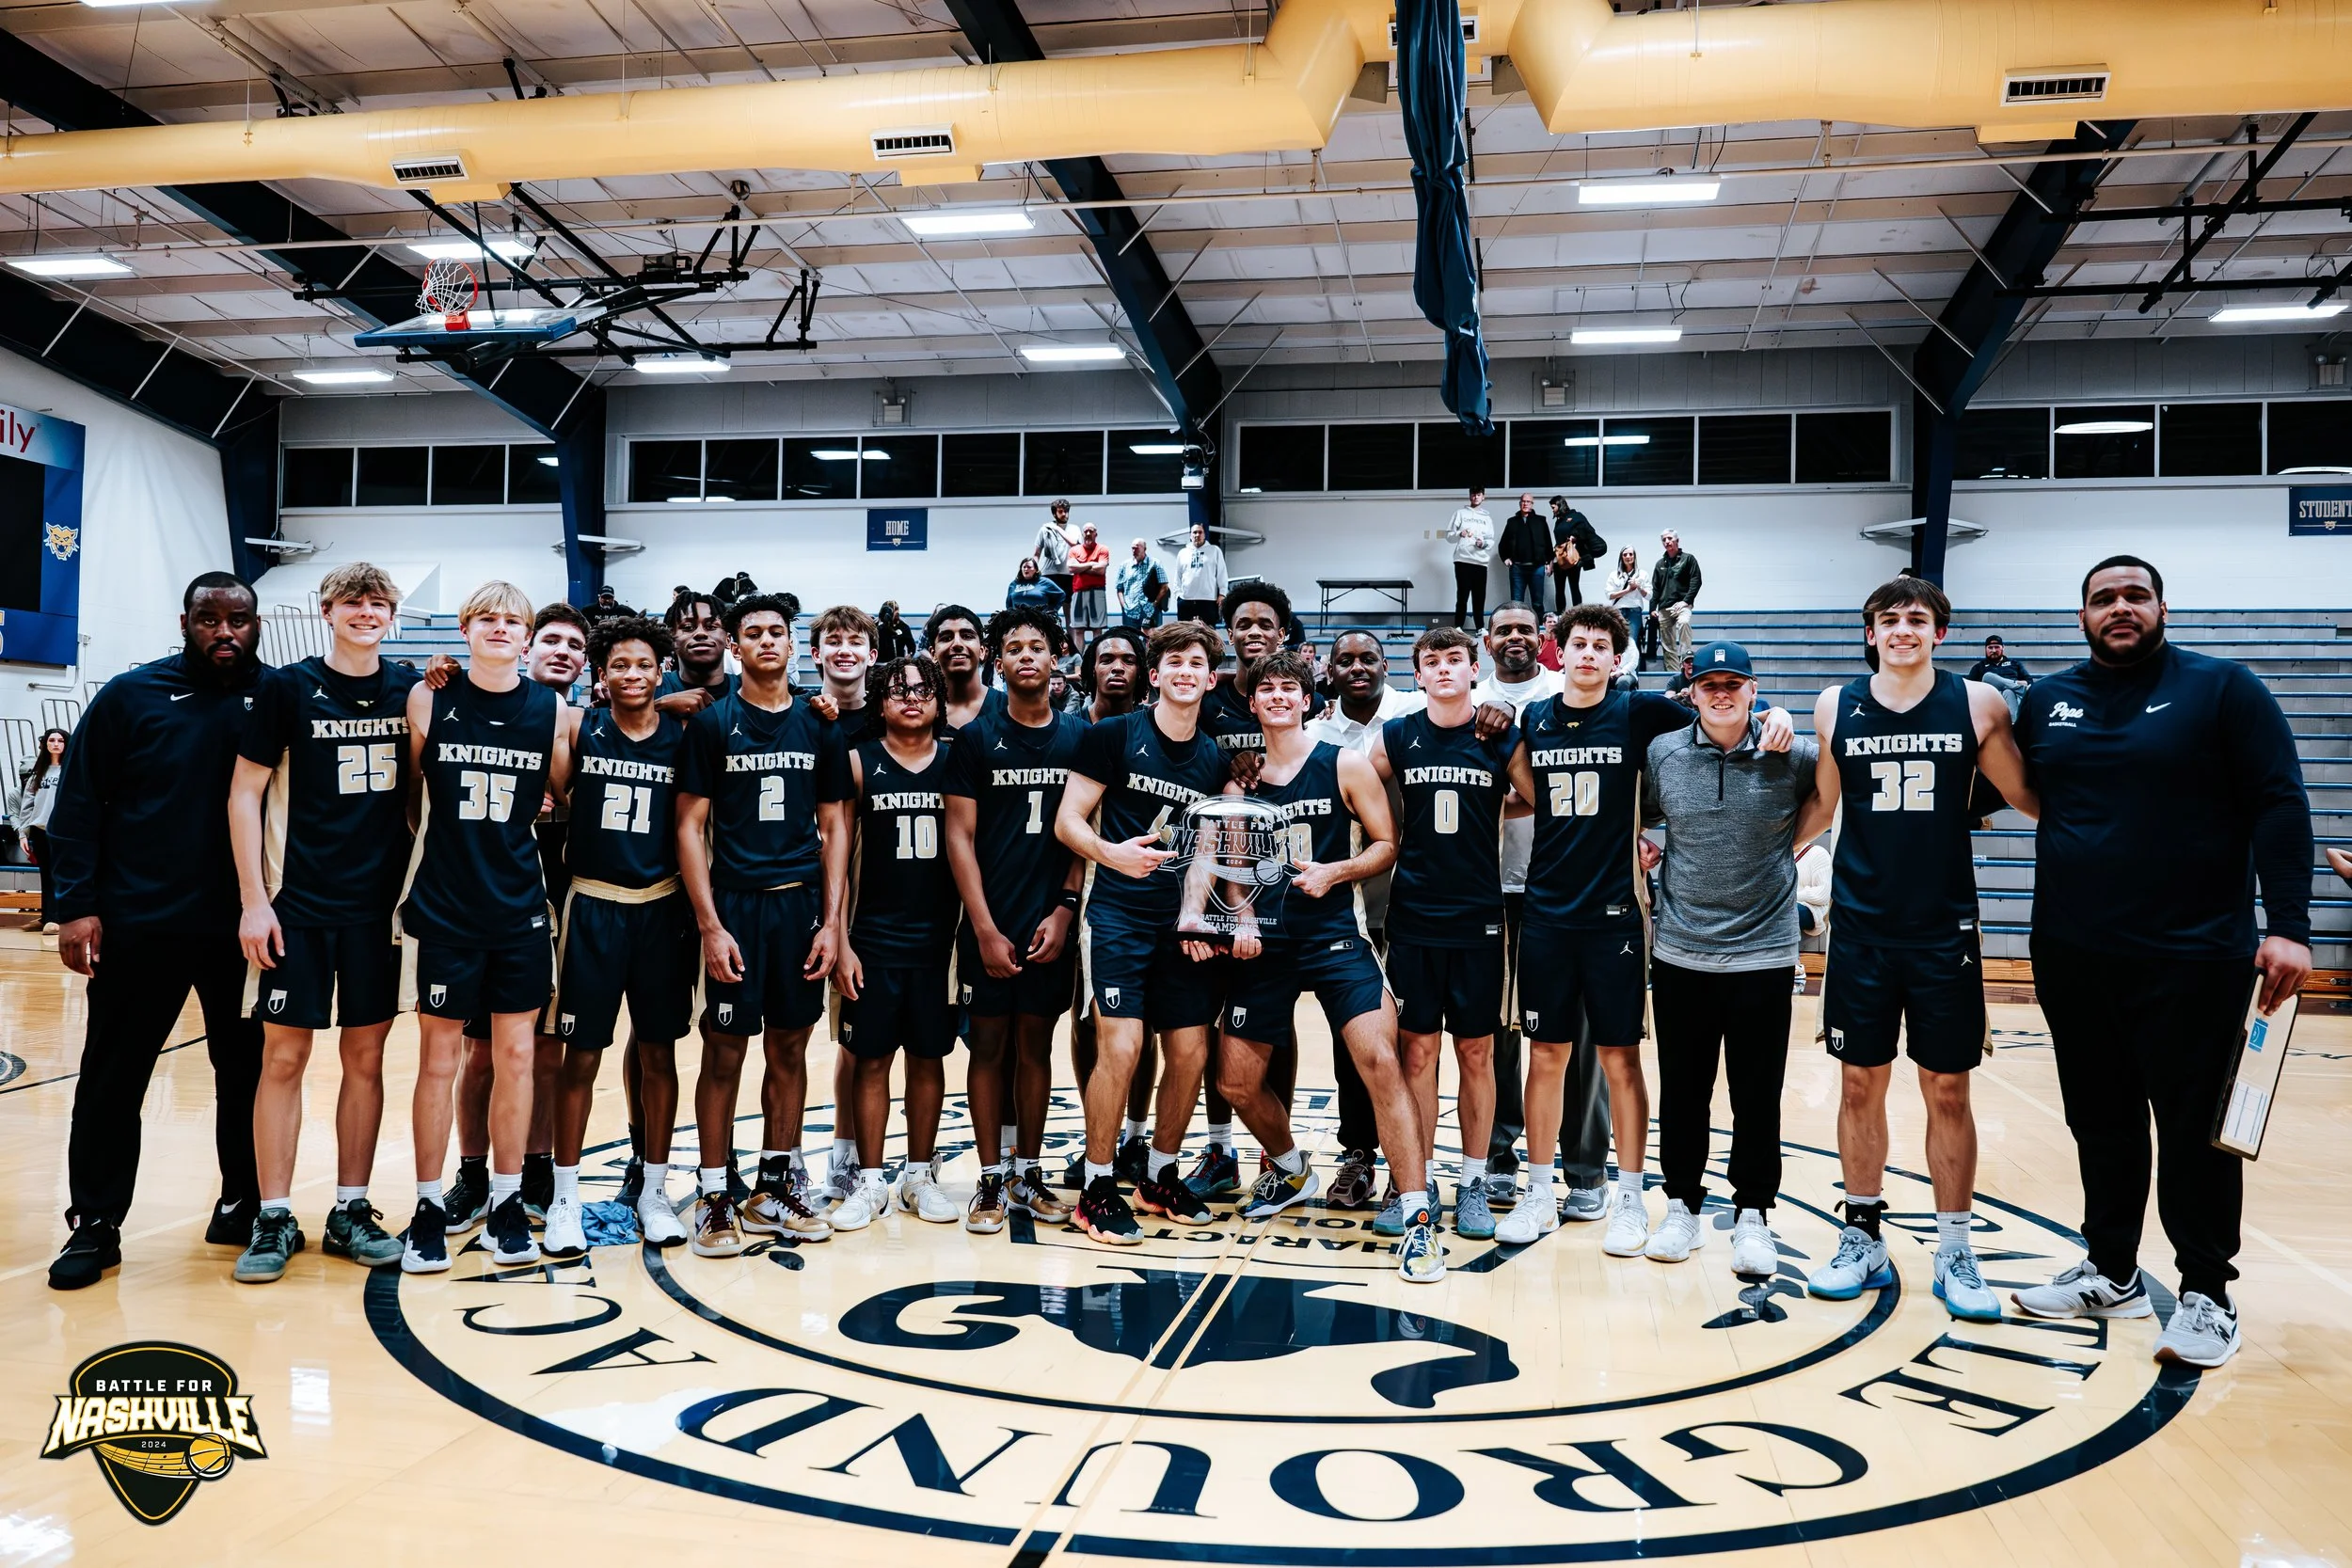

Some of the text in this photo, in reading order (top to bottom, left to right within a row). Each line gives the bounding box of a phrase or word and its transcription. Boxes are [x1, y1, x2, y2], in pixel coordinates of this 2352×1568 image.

[885, 520, 910, 536] HOME
[438, 742, 543, 770] KNIGHTS
[725, 751, 816, 773] KNIGHTS
[1532, 747, 1622, 768] KNIGHTS
[1845, 733, 1963, 756] KNIGHTS
[338, 742, 397, 795] 25
[993, 768, 1071, 785] KNIGHT
[1405, 766, 1493, 787] KNIGHTS
[1871, 760, 1935, 812] 32
[459, 769, 517, 823] 35
[601, 784, 652, 833] 21
[758, 775, 785, 821] 2
[871, 792, 945, 811] KNIGHT
[1548, 771, 1600, 816] 20
[1025, 791, 1043, 833] 1
[1200, 819, 1245, 831] BATTLE
[1434, 789, 1459, 834] 0
[897, 816, 938, 859] 10
[1226, 915, 1239, 924] FOR
[675, 1386, 1869, 1522] GROUND
